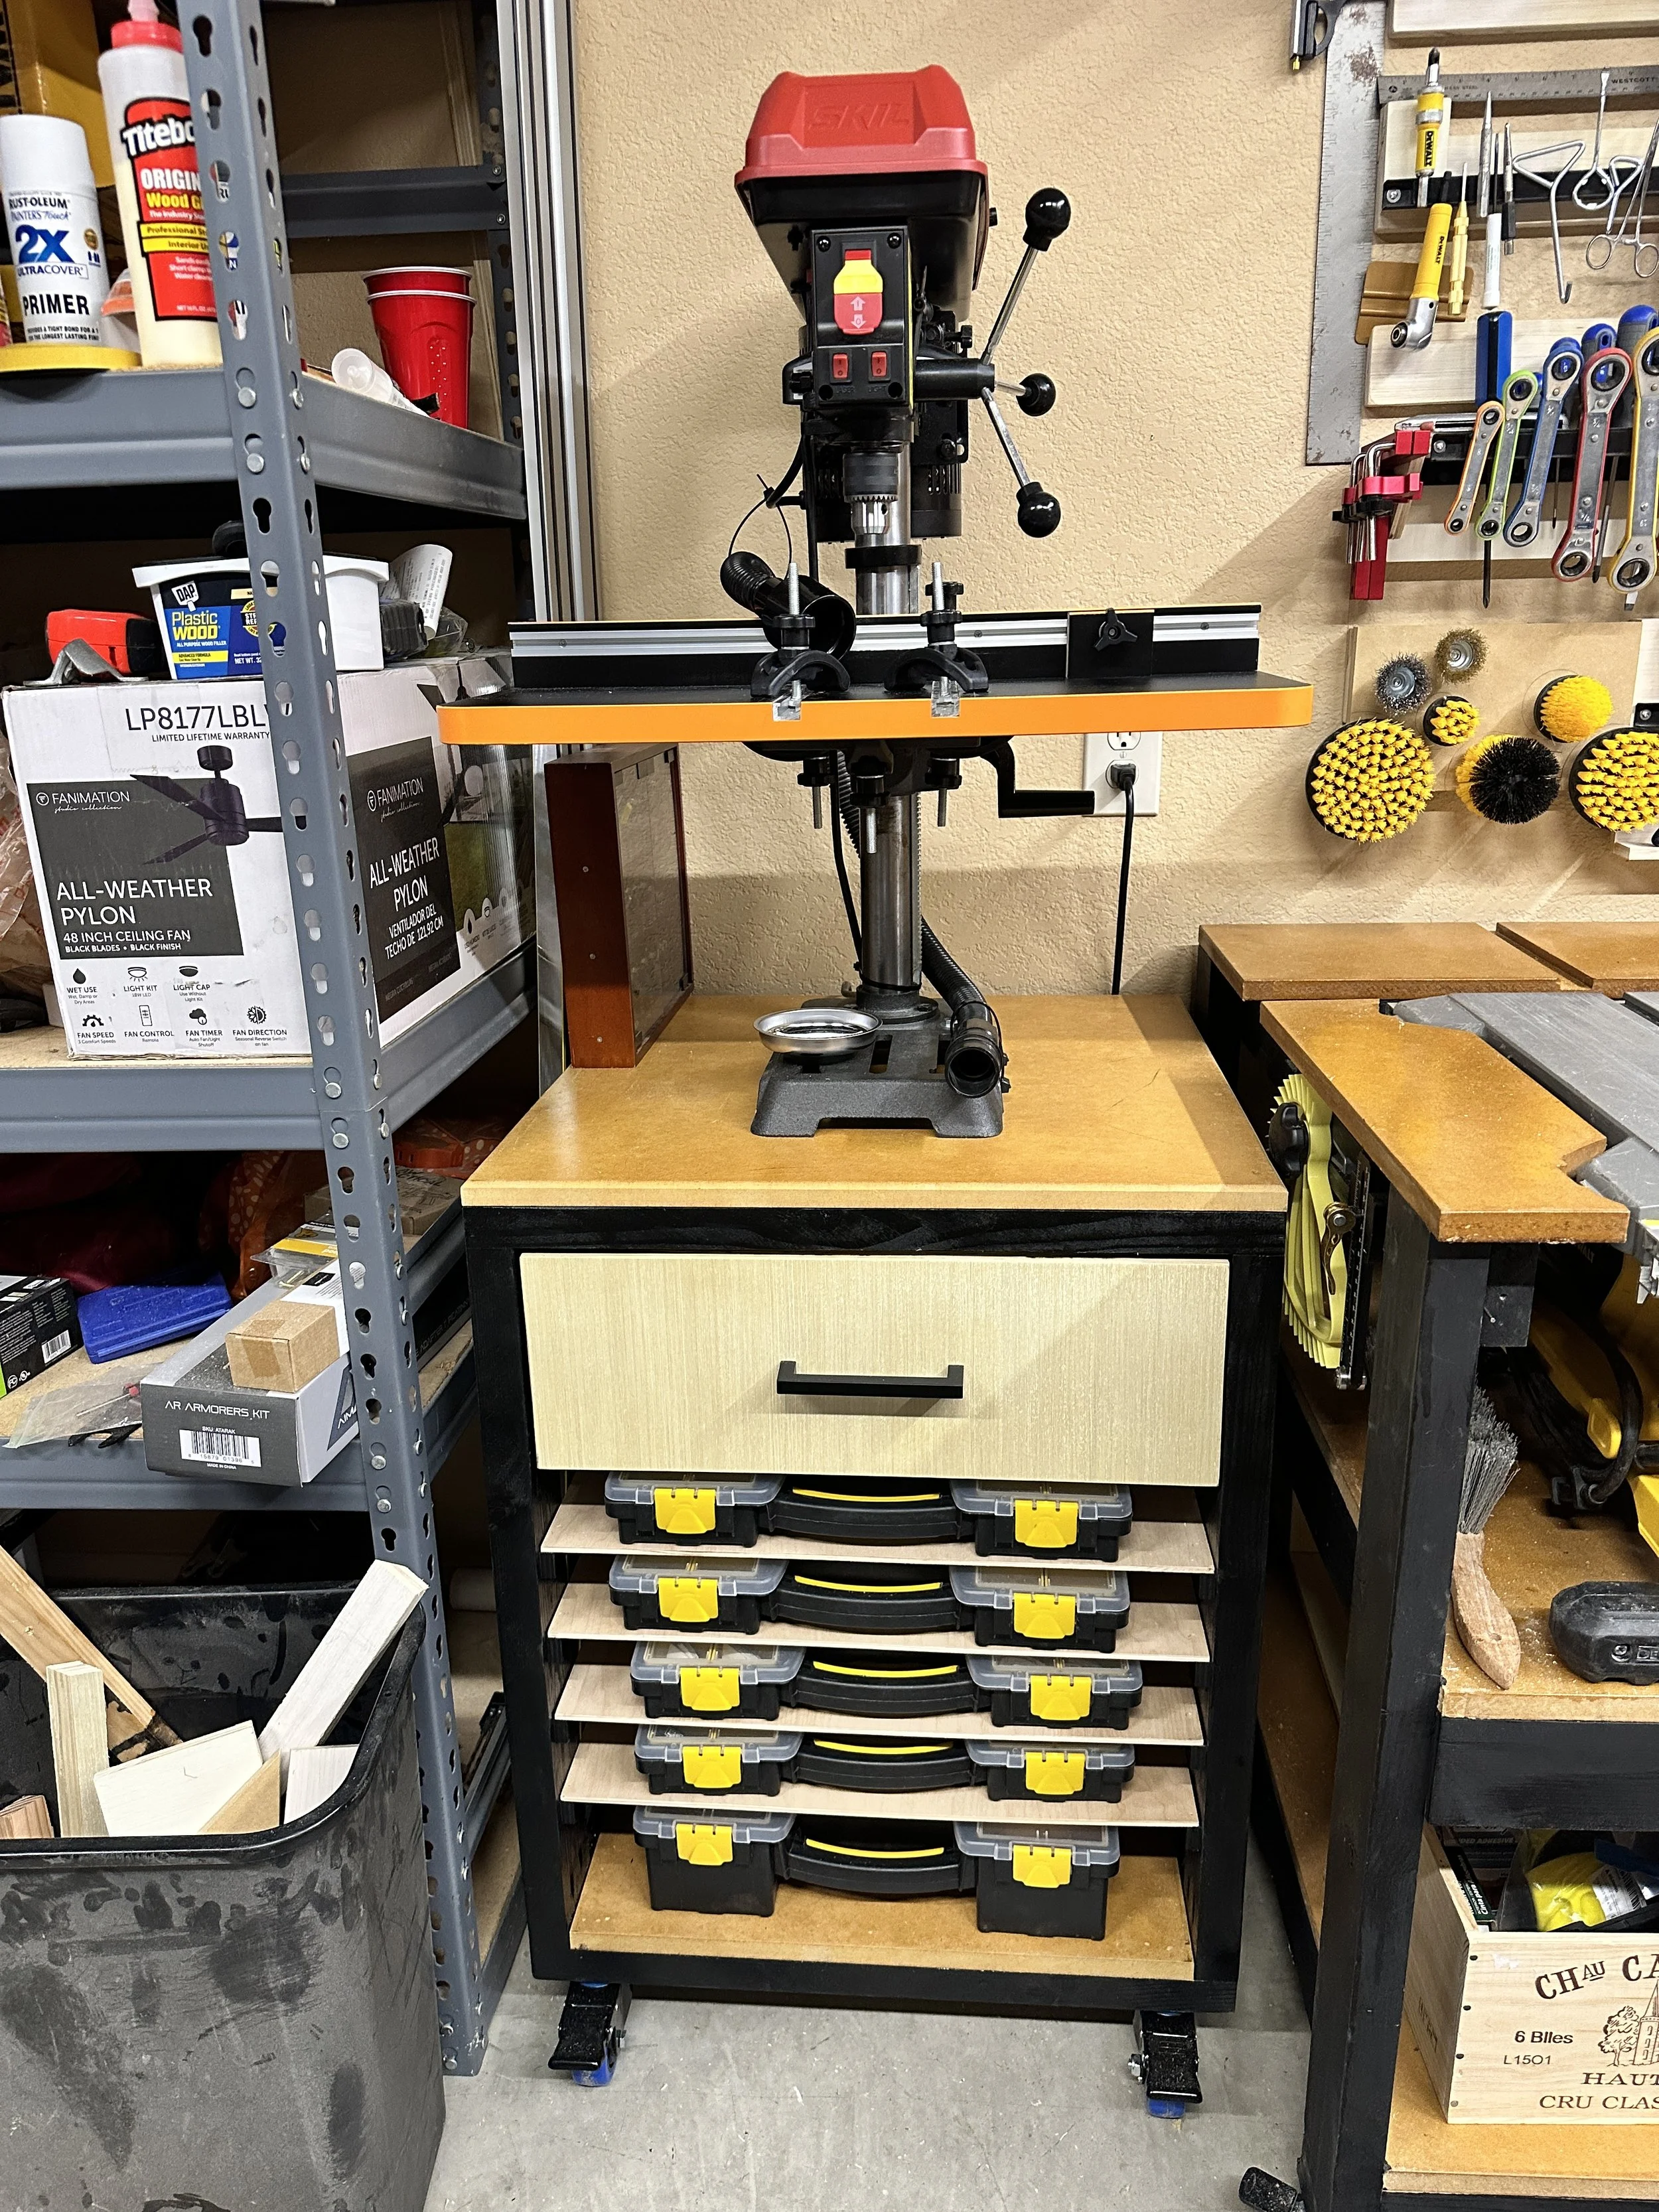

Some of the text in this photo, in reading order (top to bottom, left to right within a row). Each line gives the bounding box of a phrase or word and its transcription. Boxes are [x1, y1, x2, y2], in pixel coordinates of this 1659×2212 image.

[808, 104, 910, 131] SKIL
[122, 117, 196, 157] Titebo
[140, 168, 201, 191] ORIGIN
[146, 192, 190, 208] Wood
[165, 211, 194, 220] Industry
[146, 226, 197, 235] Professional
[15, 224, 75, 263] 2X
[168, 240, 199, 250] Interior
[17, 265, 82, 277] ULTRACOVER
[22, 294, 90, 316] PRIMER
[175, 584, 196, 602] DAP
[172, 610, 218, 627] Plastic
[173, 625, 218, 641] WOOD
[125, 703, 270, 731] LP8177LBL
[151, 731, 270, 742] LIMITED LIFETIME WARRANTY
[52, 790, 130, 804] FANIMATION
[376, 776, 424, 807] FANIMATION
[54, 804, 79, 814] studio
[380, 801, 421, 823] studio collection
[370, 836, 440, 889] ALL-WEATHER
[56, 878, 213, 901] ALL-WEATHER
[393, 875, 428, 912] PYLON
[60, 905, 136, 926] PYLON
[388, 903, 437, 939] VENTILADOR DEL
[63, 929, 190, 943] 48 INCH CEILING FAN
[385, 915, 444, 960] TECHO DE 121,92 CM
[65, 944, 90, 953] BLACK
[92, 944, 121, 952] BLADES
[165, 1400, 270, 1420] AR ARMORERS KIT
[1471, 1883, 1488, 1915] Cinta para
[1514, 2030, 1526, 2043] 6
[1539, 2095, 1594, 2109] CRU
